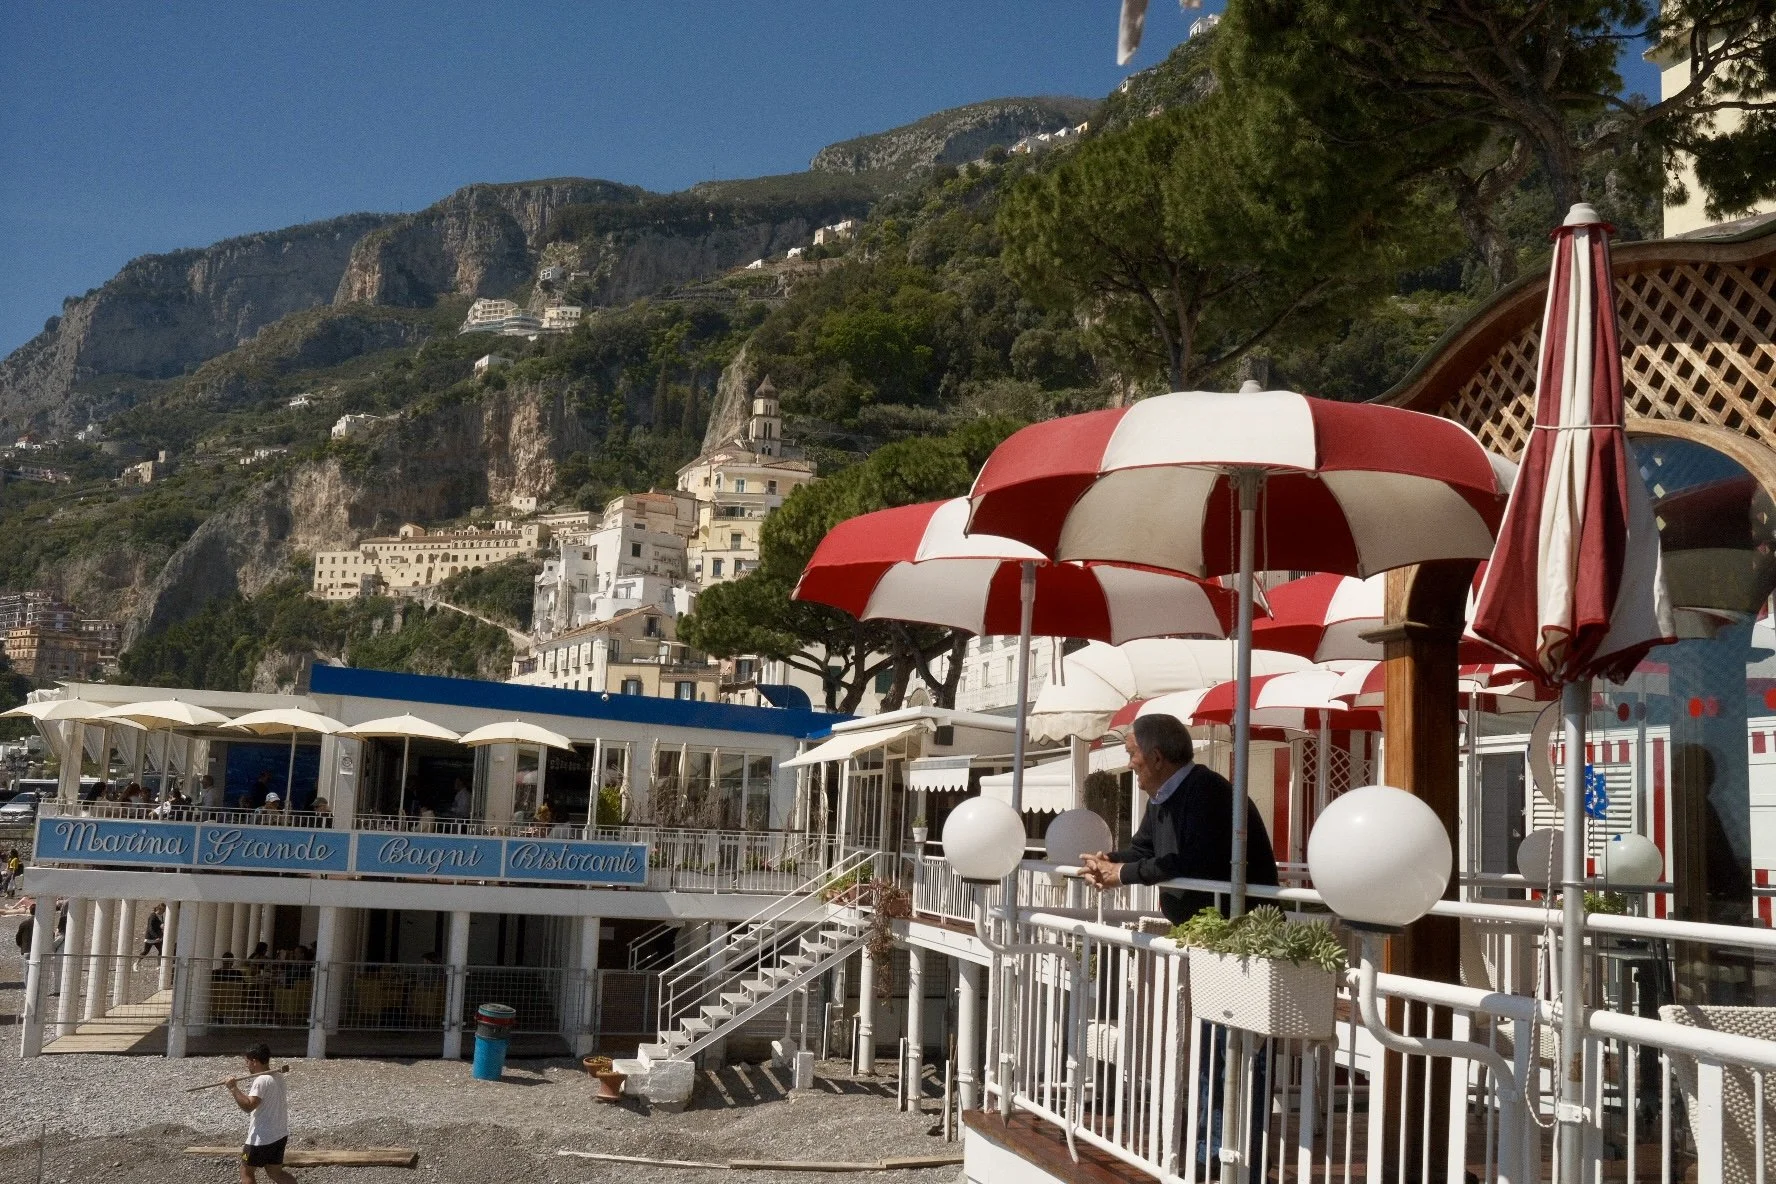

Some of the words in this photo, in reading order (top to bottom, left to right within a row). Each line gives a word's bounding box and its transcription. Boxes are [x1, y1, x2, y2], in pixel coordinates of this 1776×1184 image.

[55, 821, 189, 856] Marina
[204, 829, 336, 865] Grande
[377, 837, 485, 875] Bagni
[509, 842, 642, 874] Ristorante
